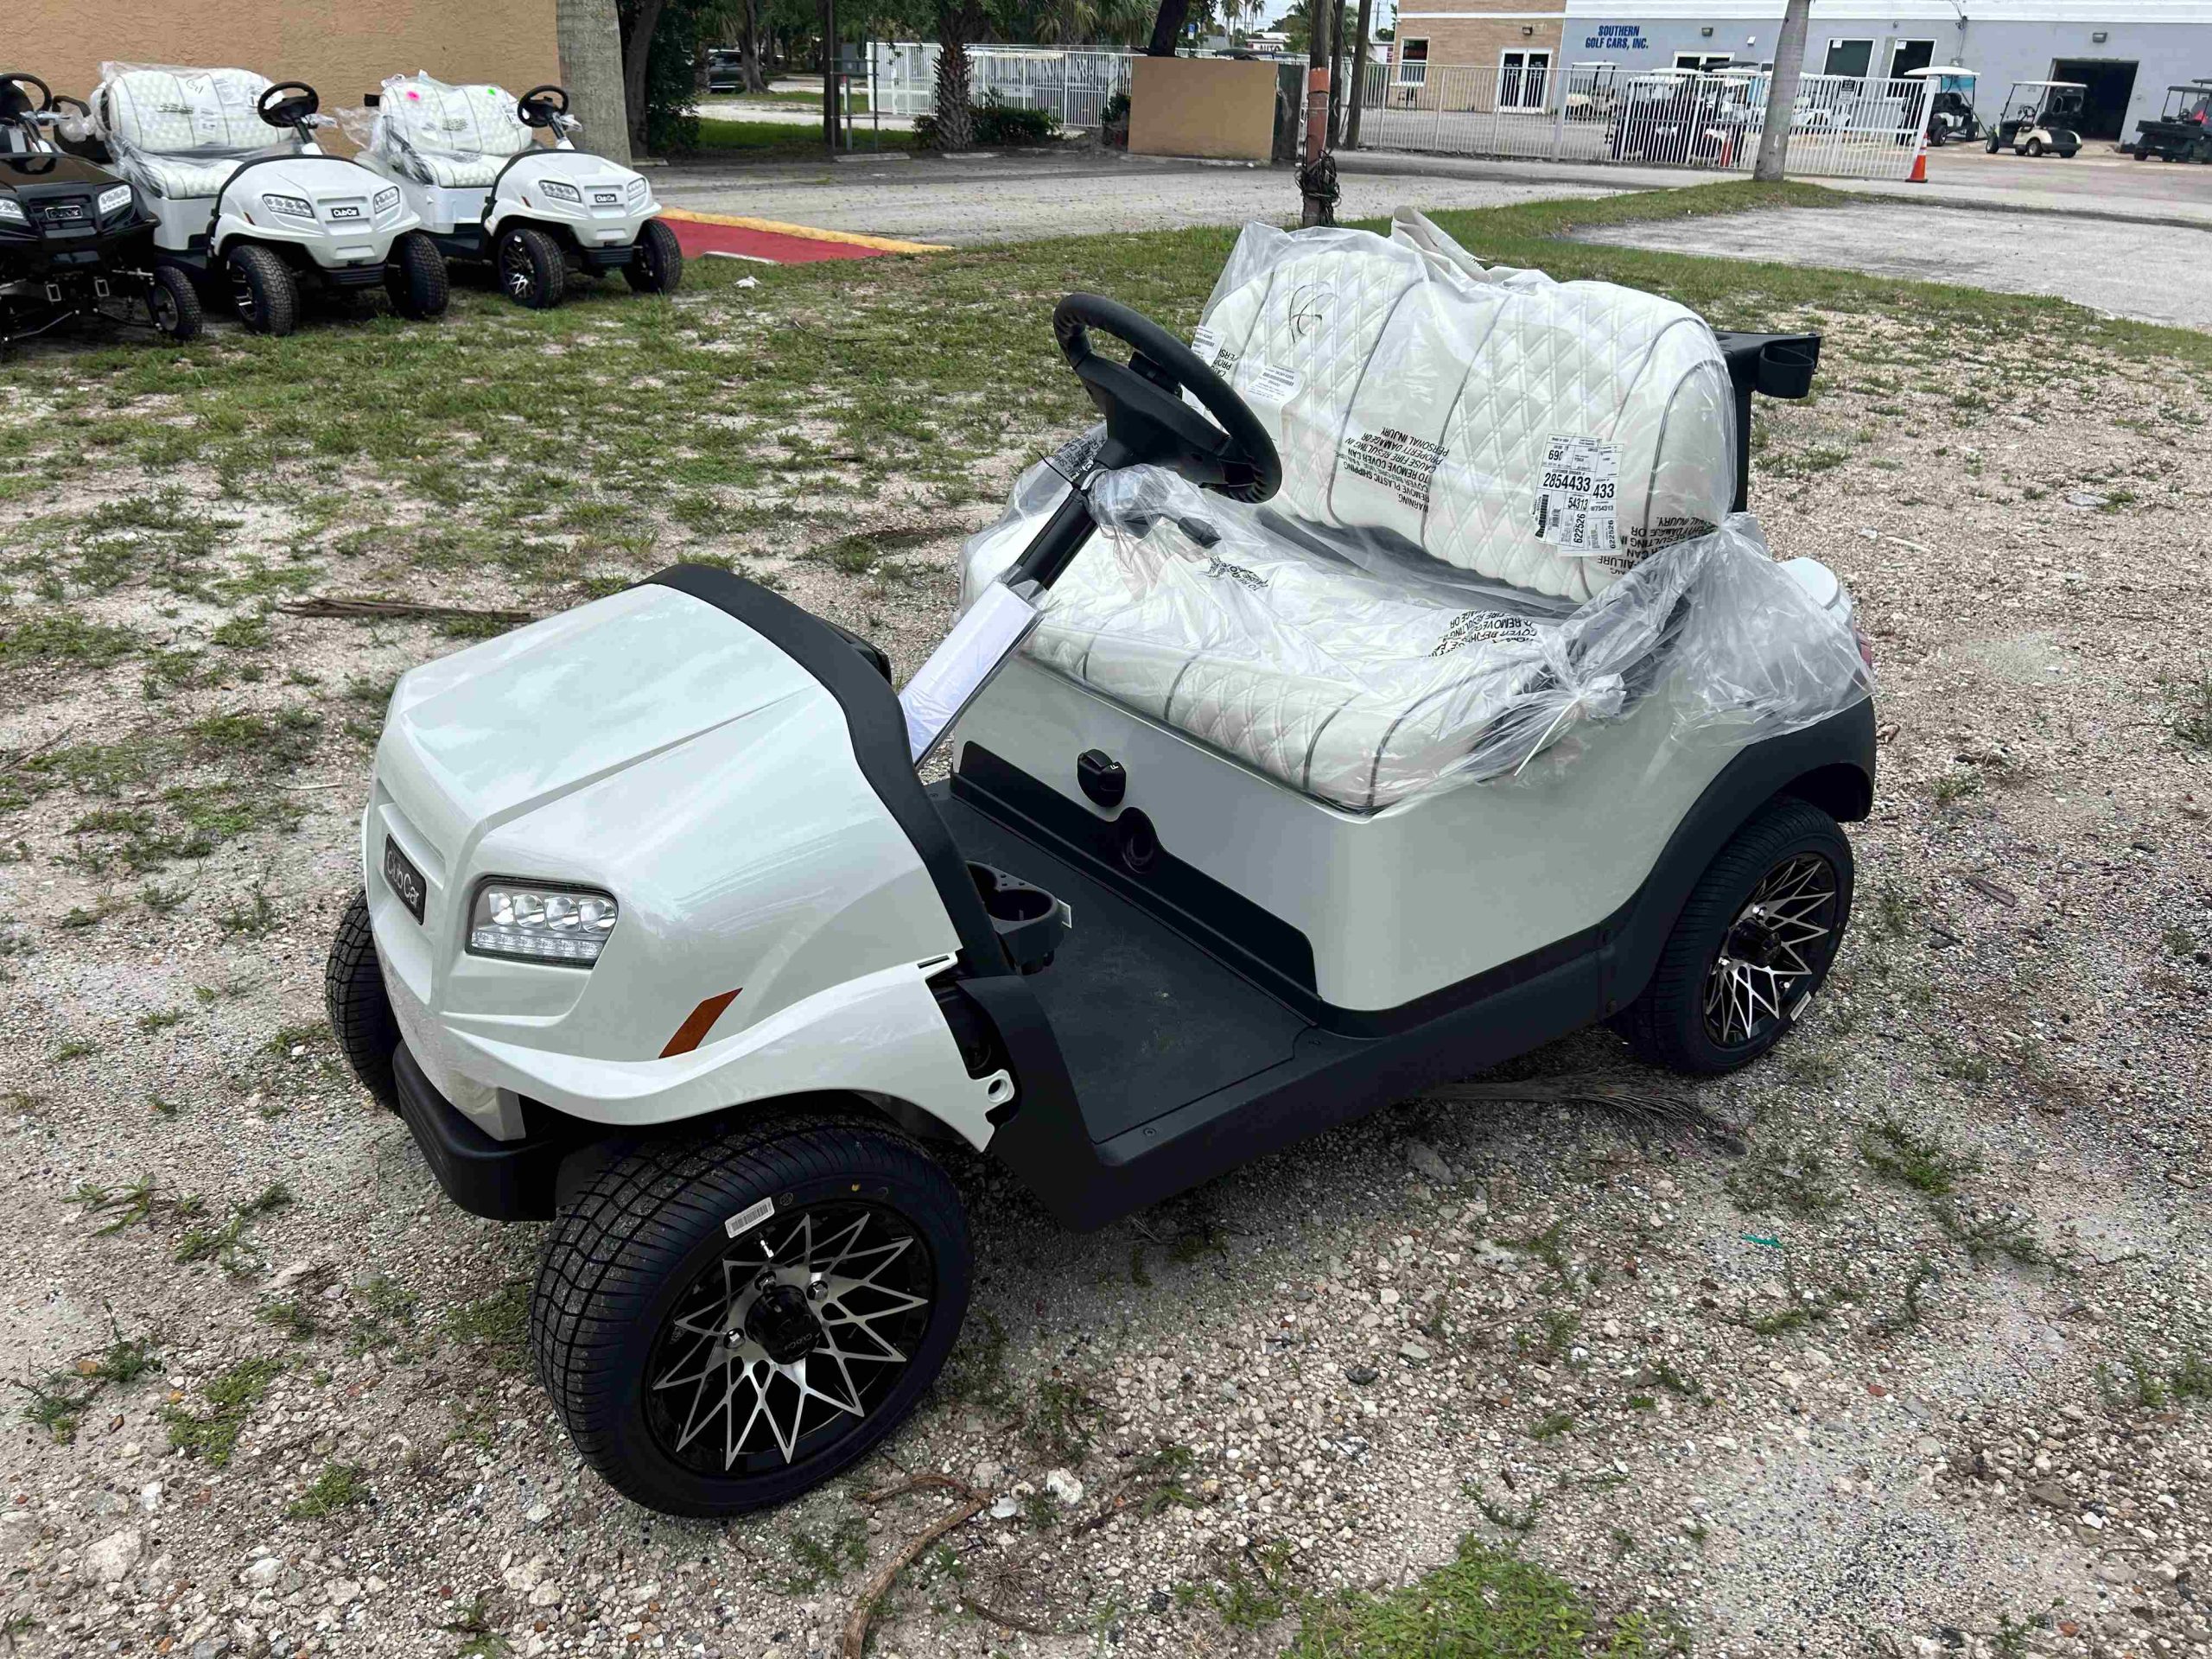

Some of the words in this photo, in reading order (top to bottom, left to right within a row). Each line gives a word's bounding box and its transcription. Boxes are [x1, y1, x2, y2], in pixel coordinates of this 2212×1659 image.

[1599, 25, 1640, 36] SOUTHERN
[1586, 37, 1605, 48] GOLF
[1606, 37, 1630, 50] CARS,
[1632, 38, 1649, 49] INC.
[1344, 437, 1355, 447] IN
[1361, 432, 1372, 442] OR
[1372, 436, 1403, 453] DAMAGE
[1356, 441, 1392, 459] RESULTING
[1408, 435, 1450, 457] PERSONAL
[1348, 448, 1362, 461] CAN
[1363, 454, 1387, 469] COVER
[1391, 452, 1409, 466] FIRE
[1403, 448, 1444, 465] PROPERTY
[1343, 461, 1373, 480] SHIPPING
[1388, 462, 1417, 480] REMOVE
[1408, 458, 1437, 474] CAUSE
[1374, 474, 1401, 491] PLASTIC
[1418, 473, 1429, 483] TO
[1543, 473, 1591, 493] 2854433
[1404, 479, 1428, 493] COVER
[1402, 486, 1430, 503] REMOVE
[1573, 513, 1586, 543] 622526
[1630, 525, 1647, 537] OR
[1626, 548, 1649, 560] CAN
[1450, 616, 1459, 628] OR
